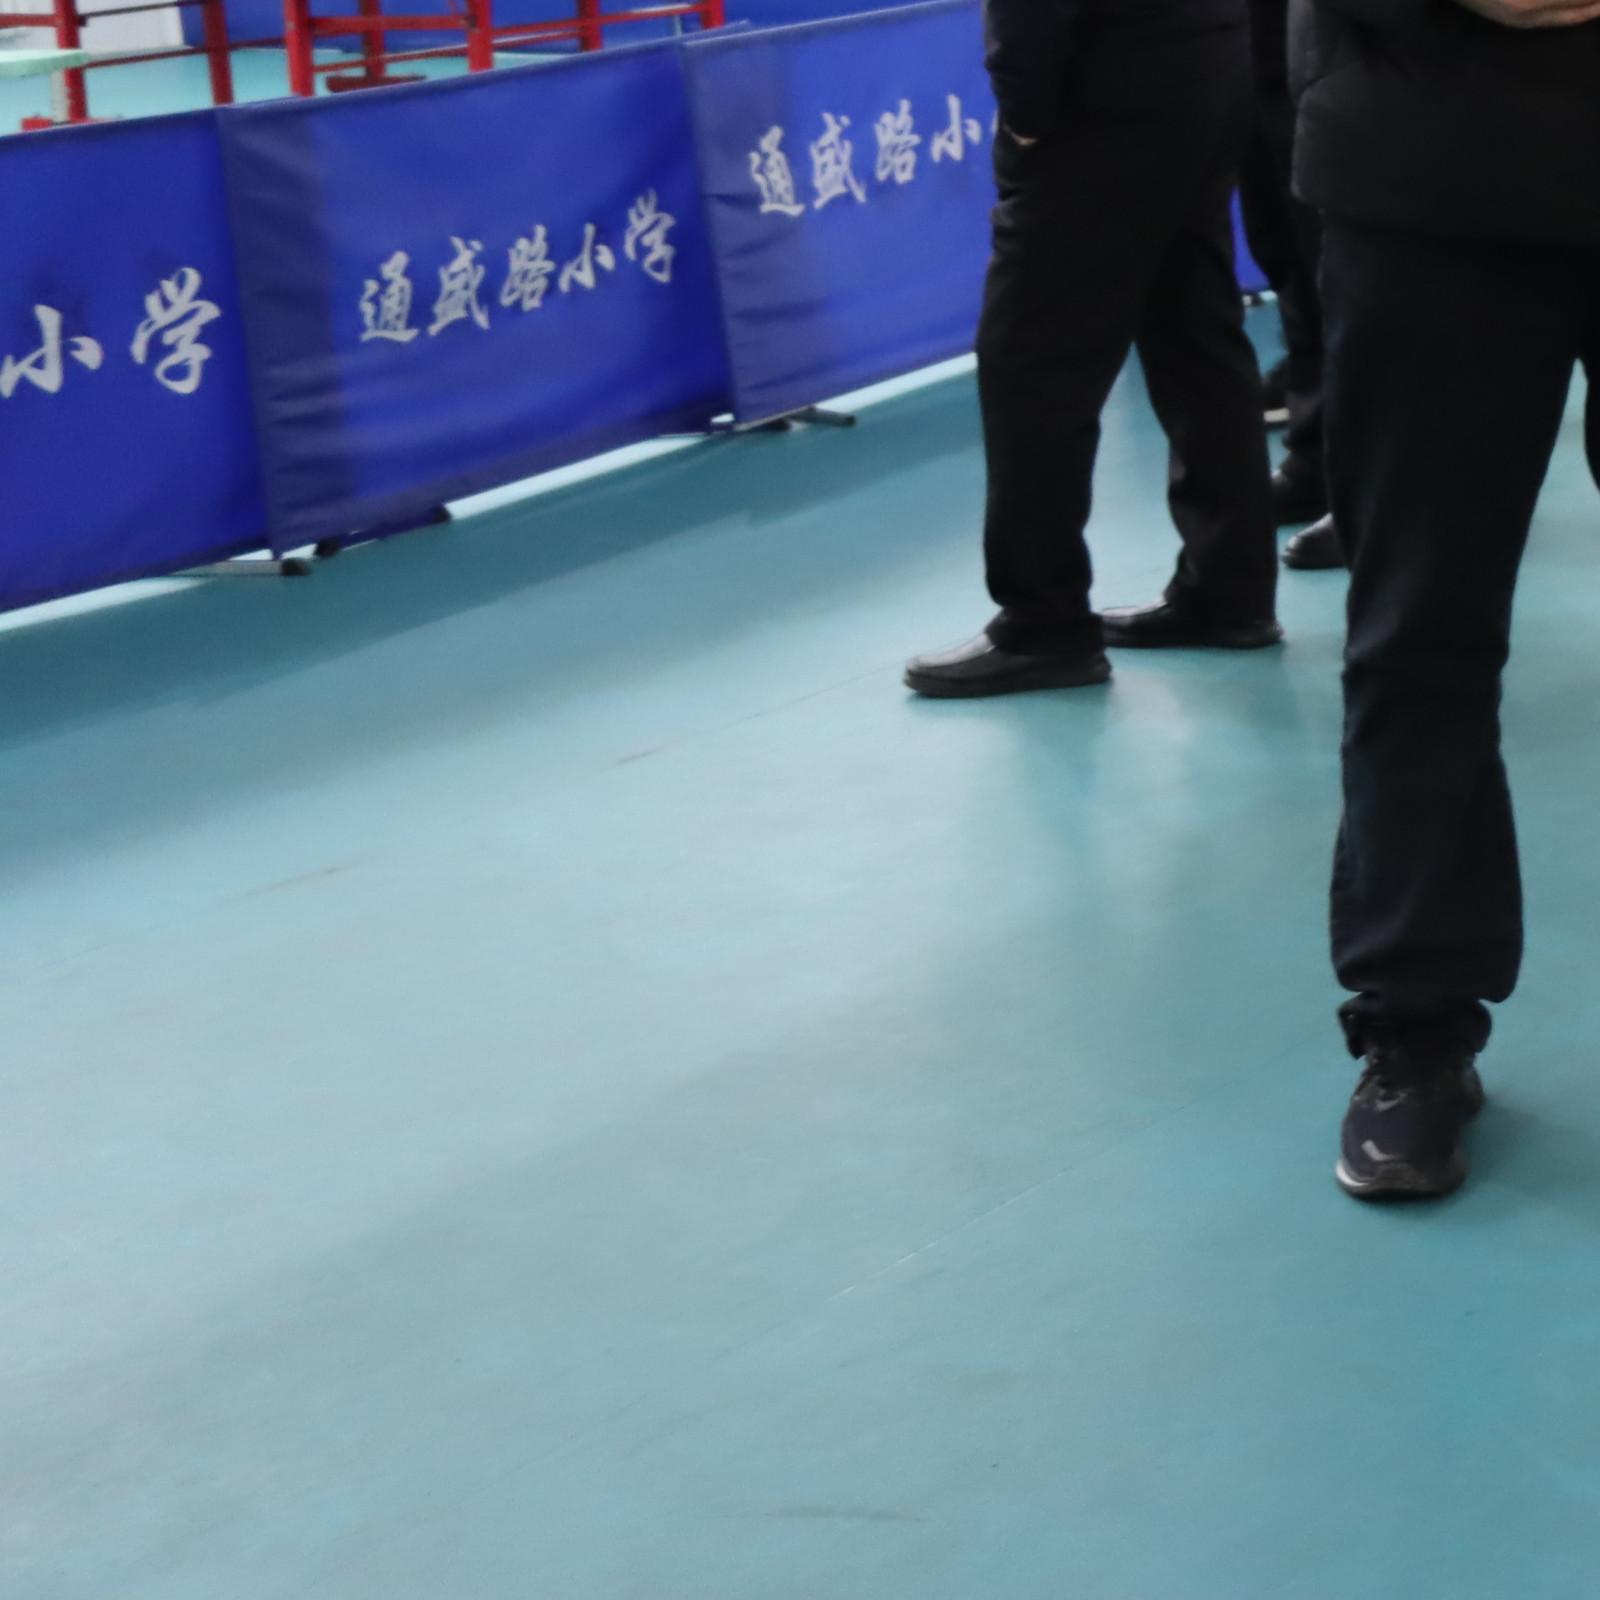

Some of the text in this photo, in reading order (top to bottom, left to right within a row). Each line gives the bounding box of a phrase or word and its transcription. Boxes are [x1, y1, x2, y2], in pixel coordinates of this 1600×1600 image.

[749, 93, 998, 216] 通盛路小
[0, 266, 222, 398] 小学
